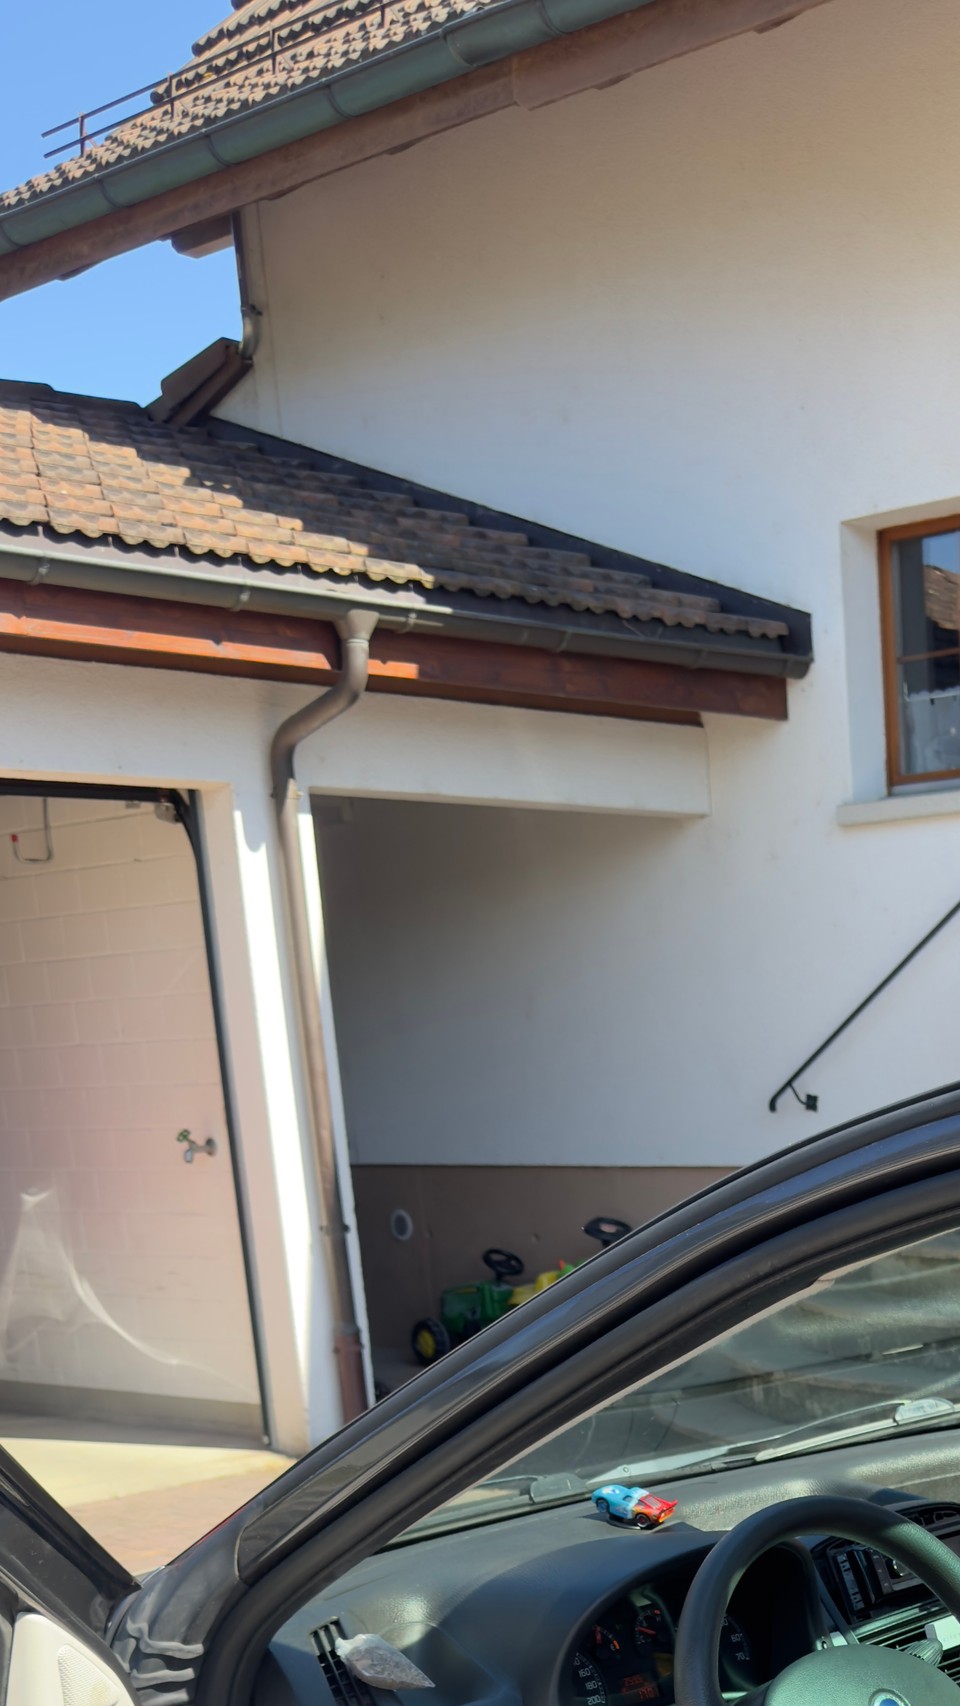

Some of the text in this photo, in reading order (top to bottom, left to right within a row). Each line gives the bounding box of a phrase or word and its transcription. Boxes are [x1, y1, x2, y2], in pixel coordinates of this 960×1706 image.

[578, 1667, 591, 1678] 160
[585, 1680, 598, 1690] 180
[586, 1694, 601, 1706] 200
